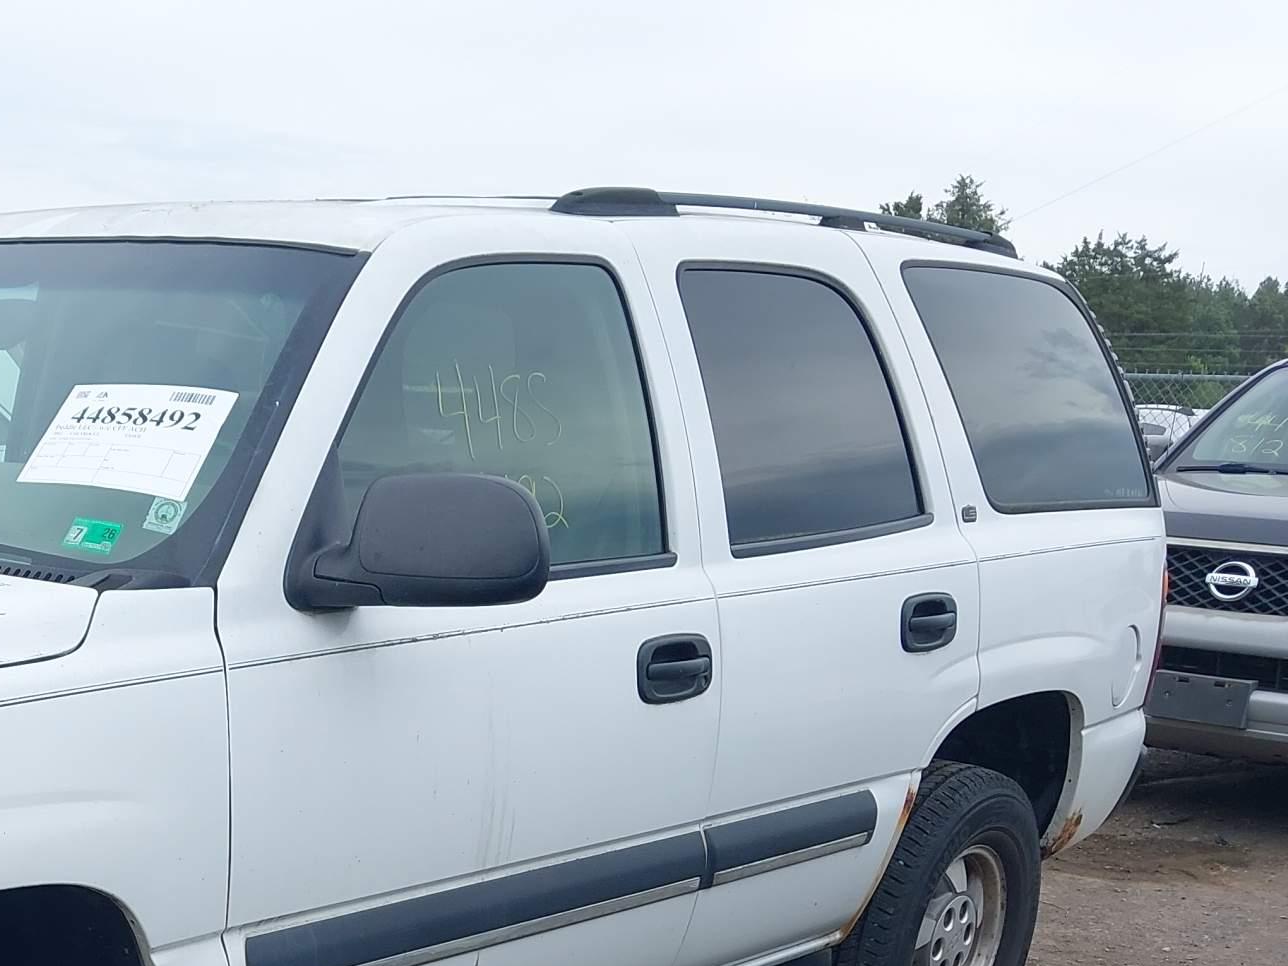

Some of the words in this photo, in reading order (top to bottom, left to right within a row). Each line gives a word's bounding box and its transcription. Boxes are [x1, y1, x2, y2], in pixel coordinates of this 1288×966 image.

[71, 405, 201, 431] 44858492
[434, 359, 562, 461] 4485
[72, 527, 83, 541] 7
[103, 527, 117, 540] 26
[1209, 575, 1252, 585] NISSAN
